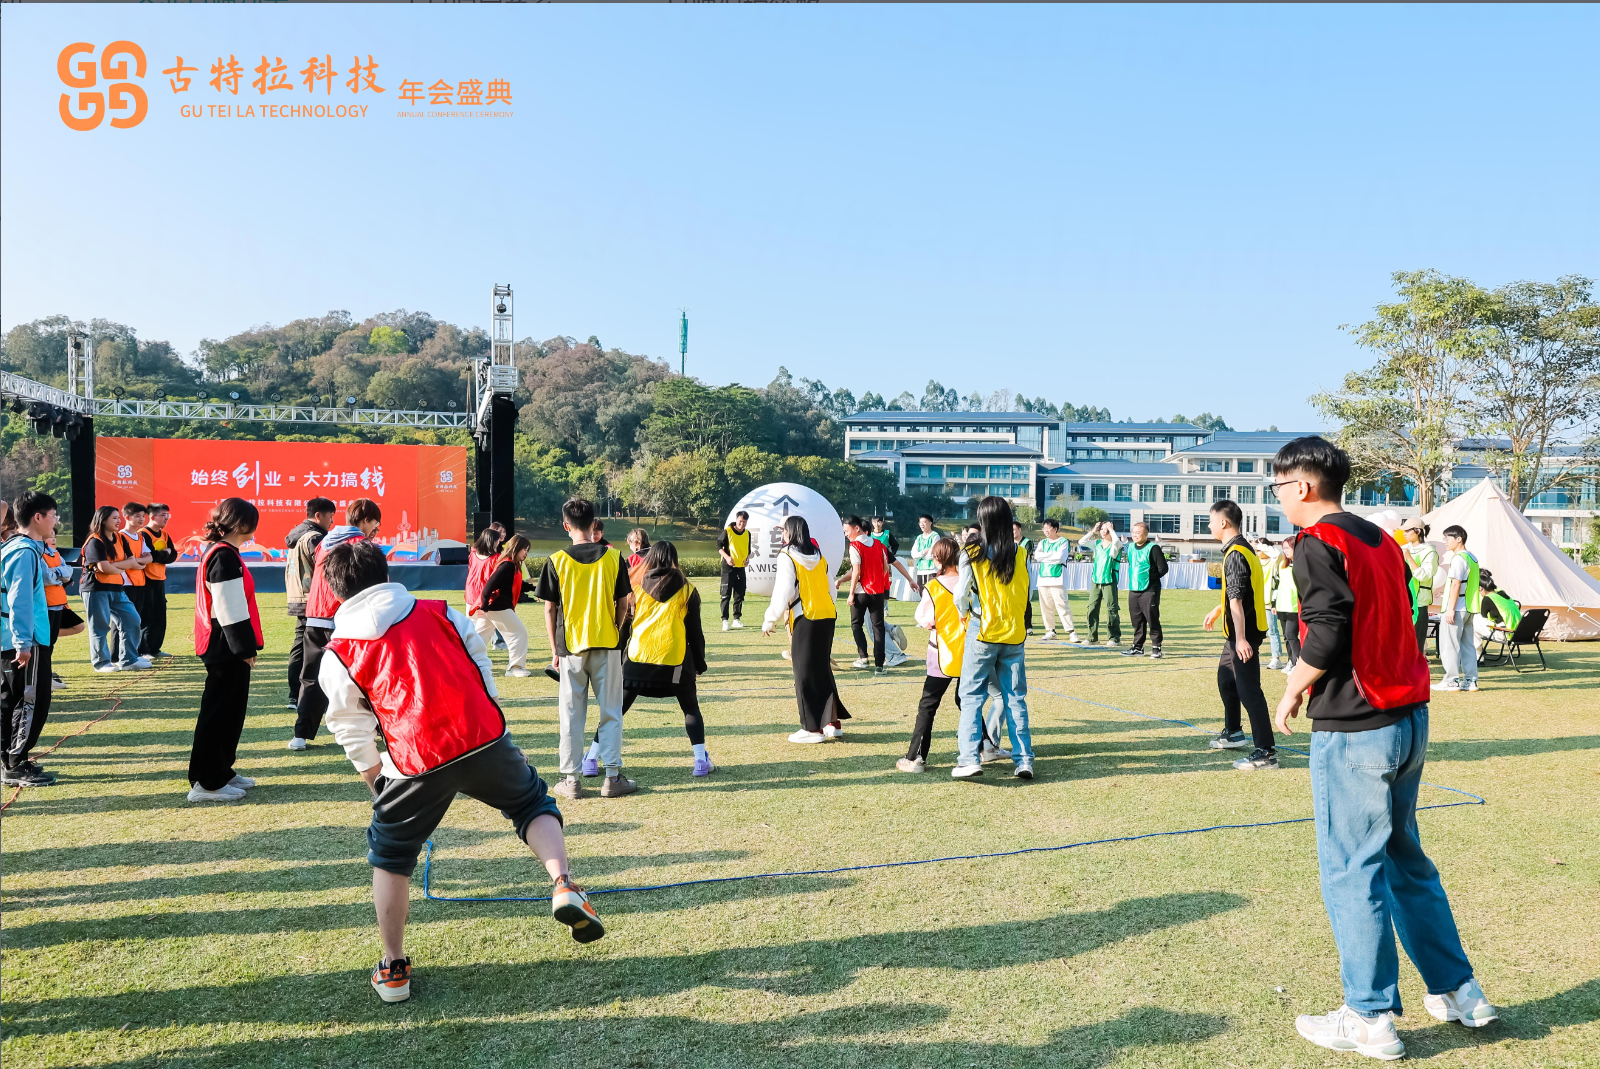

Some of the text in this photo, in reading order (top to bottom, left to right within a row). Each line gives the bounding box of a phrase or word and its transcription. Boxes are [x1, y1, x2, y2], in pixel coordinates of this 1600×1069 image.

[190, 460, 386, 497] 始终创业 大力搞钱
[748, 563, 778, 573] A WIS
